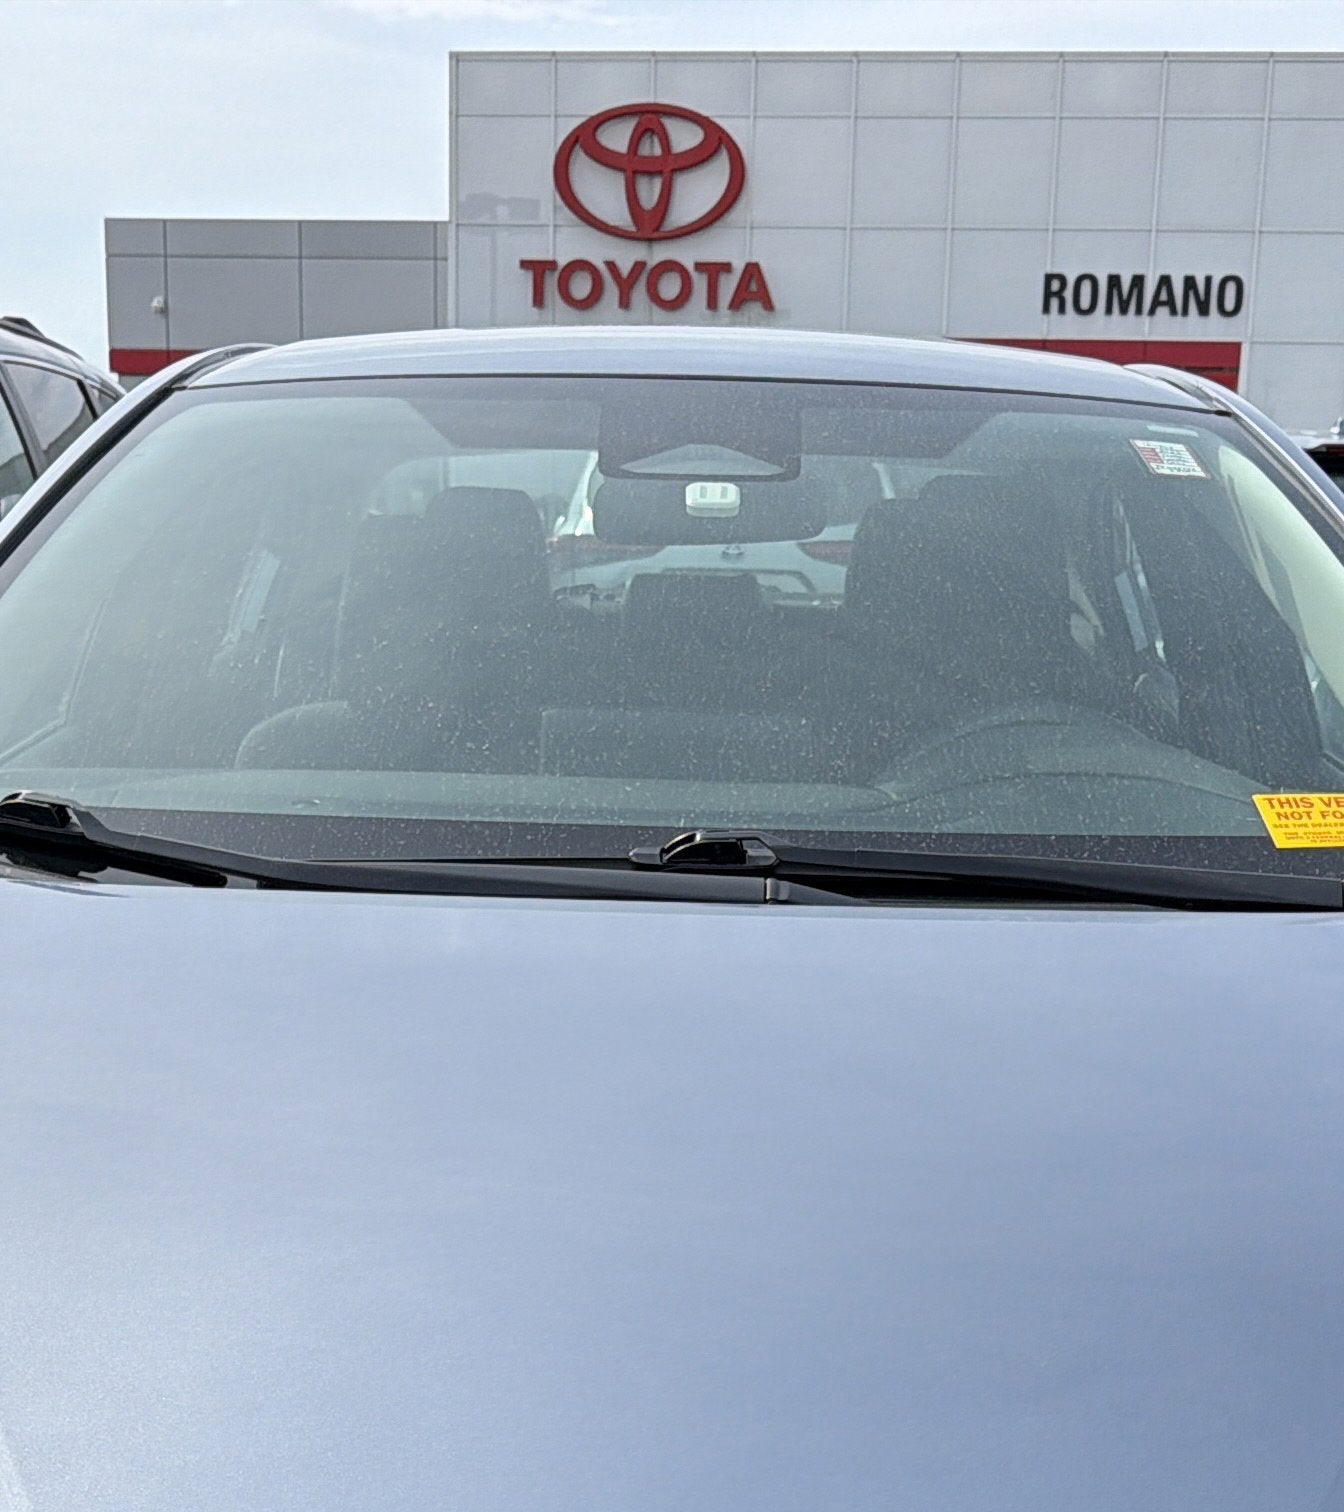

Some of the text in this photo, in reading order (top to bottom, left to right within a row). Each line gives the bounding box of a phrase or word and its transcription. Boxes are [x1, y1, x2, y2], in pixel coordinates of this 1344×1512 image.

[519, 258, 775, 312] TOYOTA
[1041, 272, 1245, 318] ROMANO
[1263, 796, 1315, 810] THIS
[1275, 810, 1313, 821] NOT
